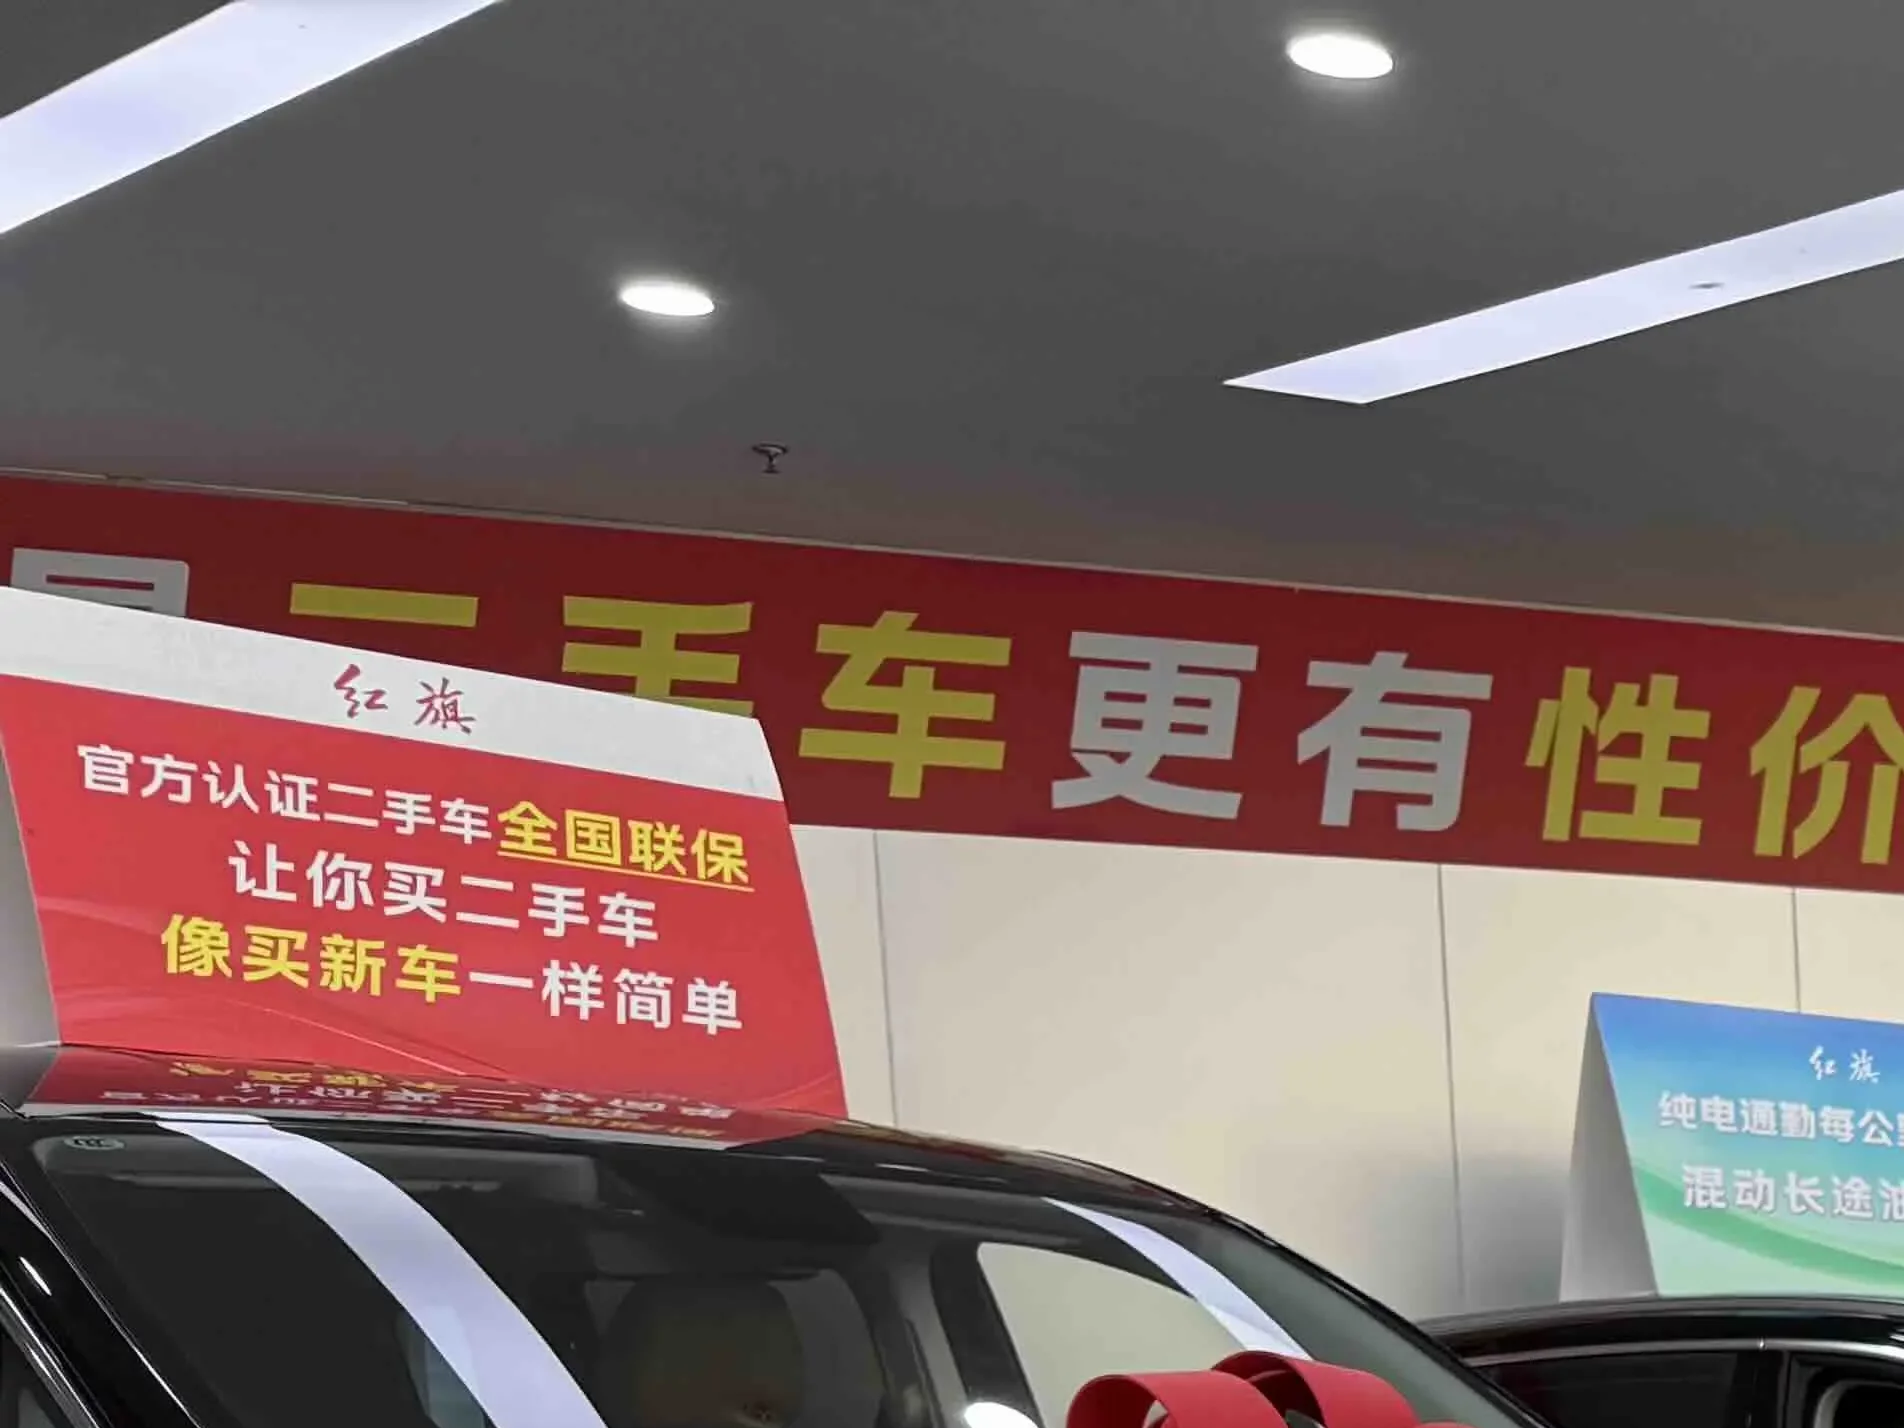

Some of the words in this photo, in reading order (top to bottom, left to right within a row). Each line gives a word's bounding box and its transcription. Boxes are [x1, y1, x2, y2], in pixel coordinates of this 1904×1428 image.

[332, 663, 478, 735] 红旗
[77, 744, 749, 885] 官方认证二手车全国联保
[228, 840, 660, 948] 让你买二手车
[161, 913, 744, 1036] 像买新车一样简单
[1809, 1045, 1881, 1084] 红旗
